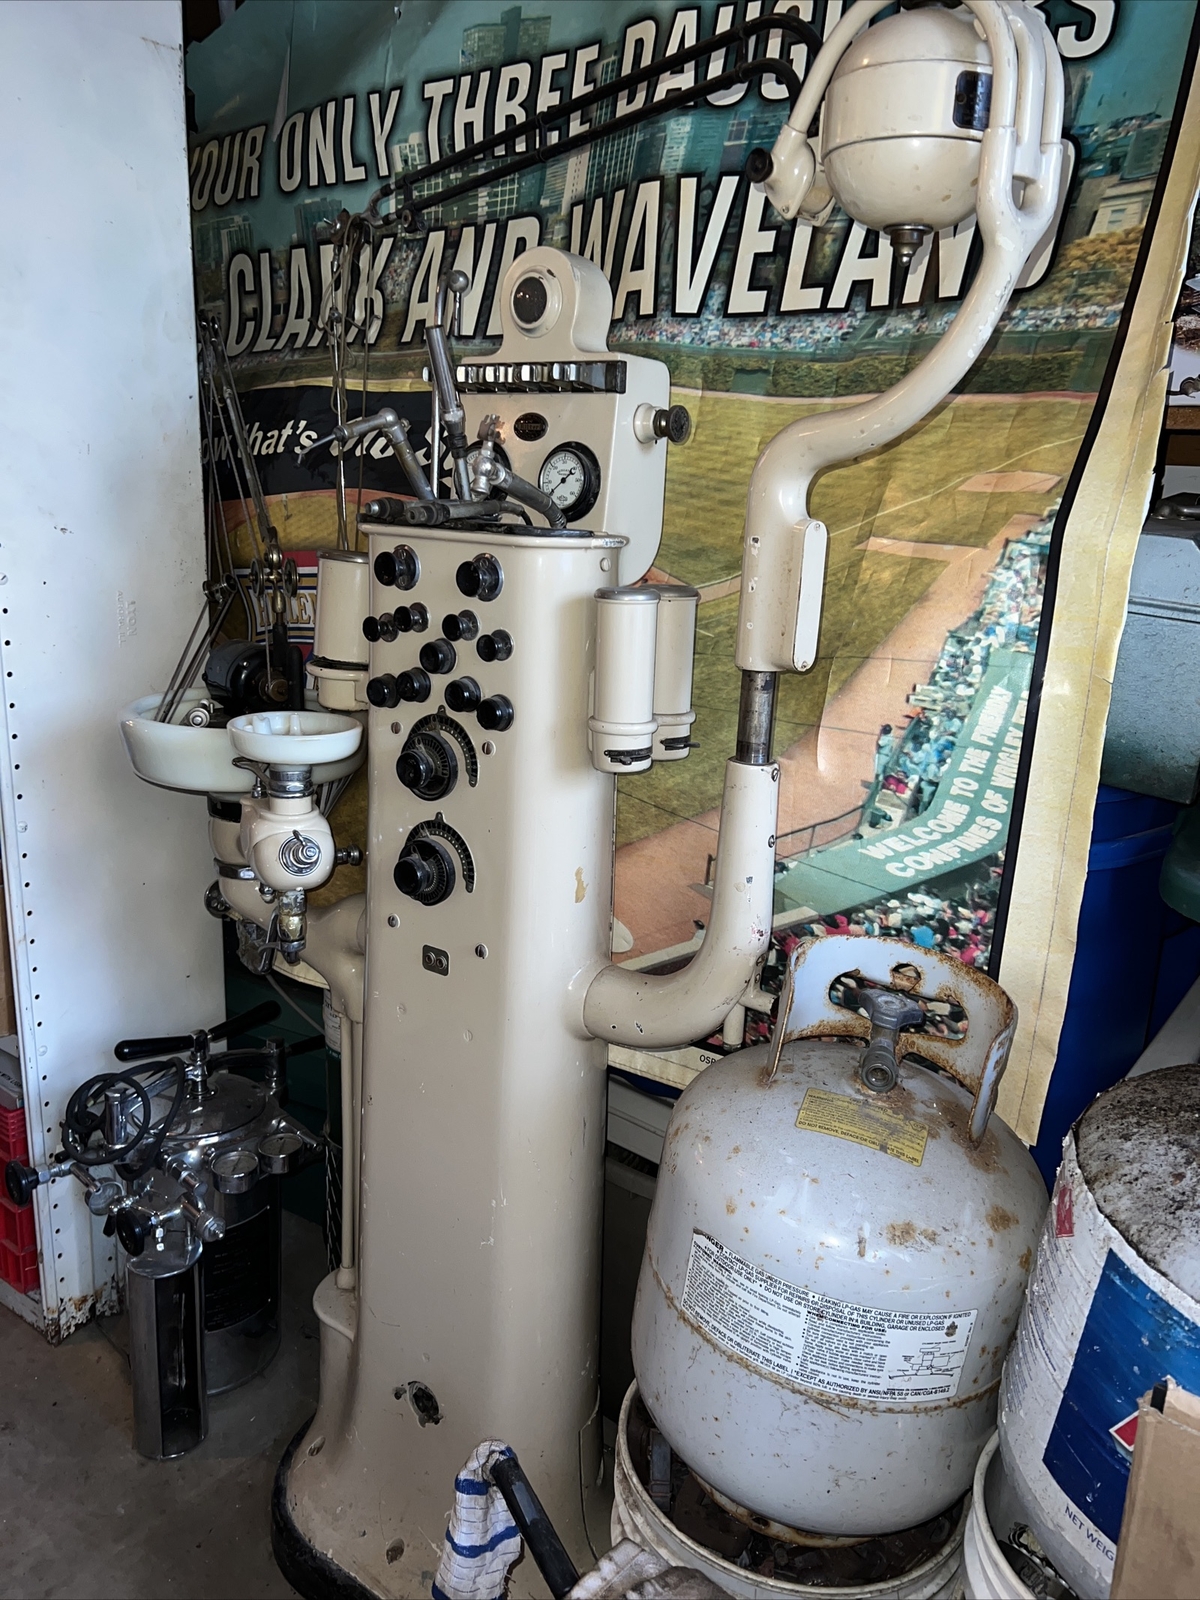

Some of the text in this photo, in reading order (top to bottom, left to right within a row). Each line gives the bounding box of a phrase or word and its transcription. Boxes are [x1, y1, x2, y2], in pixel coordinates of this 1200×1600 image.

[280, 88, 402, 192] ONLY
[424, 45, 601, 165] THREE
[226, 237, 394, 357] CLARK
[572, 143, 1073, 319] WAVELAN
[858, 685, 1012, 860] WELCOME TO THE FRIENDLY
[990, 726, 1023, 788] WRIGLEY
[981, 789, 1009, 814] OF
[886, 815, 1002, 878] CONFINES
[841, 1131, 859, 1140] DEFACE
[906, 1154, 919, 1163] LABEL
[715, 1254, 734, 1270] OUTDOOR
[734, 1269, 743, 1277] USE
[772, 1290, 783, 1298] NOT
[783, 1295, 793, 1303] USE
[803, 1303, 820, 1312] STORE
[821, 1310, 847, 1320] CYLINDER
[887, 1323, 908, 1331] GARAGE
[720, 1252, 738, 1267] CONTACT
[738, 1264, 754, 1277] LP-GAS
[755, 1274, 777, 1289] SUPPLIER
[778, 1286, 788, 1294] FOR
[789, 1291, 810, 1303] REPAIRS
[820, 1302, 845, 1314] DISPOSAL
[869, 1315, 895, 1323] CYLINDER
[729, 1251, 754, 1271] FLAMMABLE
[755, 1269, 764, 1277] GAS
[765, 1273, 782, 1285] UNDER
[783, 1282, 809, 1297] PRESSURE
[818, 1296, 841, 1307] LEAKING
[842, 1303, 861, 1312] LP-GAS
[874, 1310, 892, 1318] CAUSE
[727, 1335, 734, 1343] OR
[734, 1340, 760, 1359] OBLITERATE
[762, 1355, 772, 1365] THIS
[773, 1361, 789, 1372] LABEL
[826, 1380, 860, 1392] AUTHORIZED
[1065, 1504, 1085, 1529] NET
